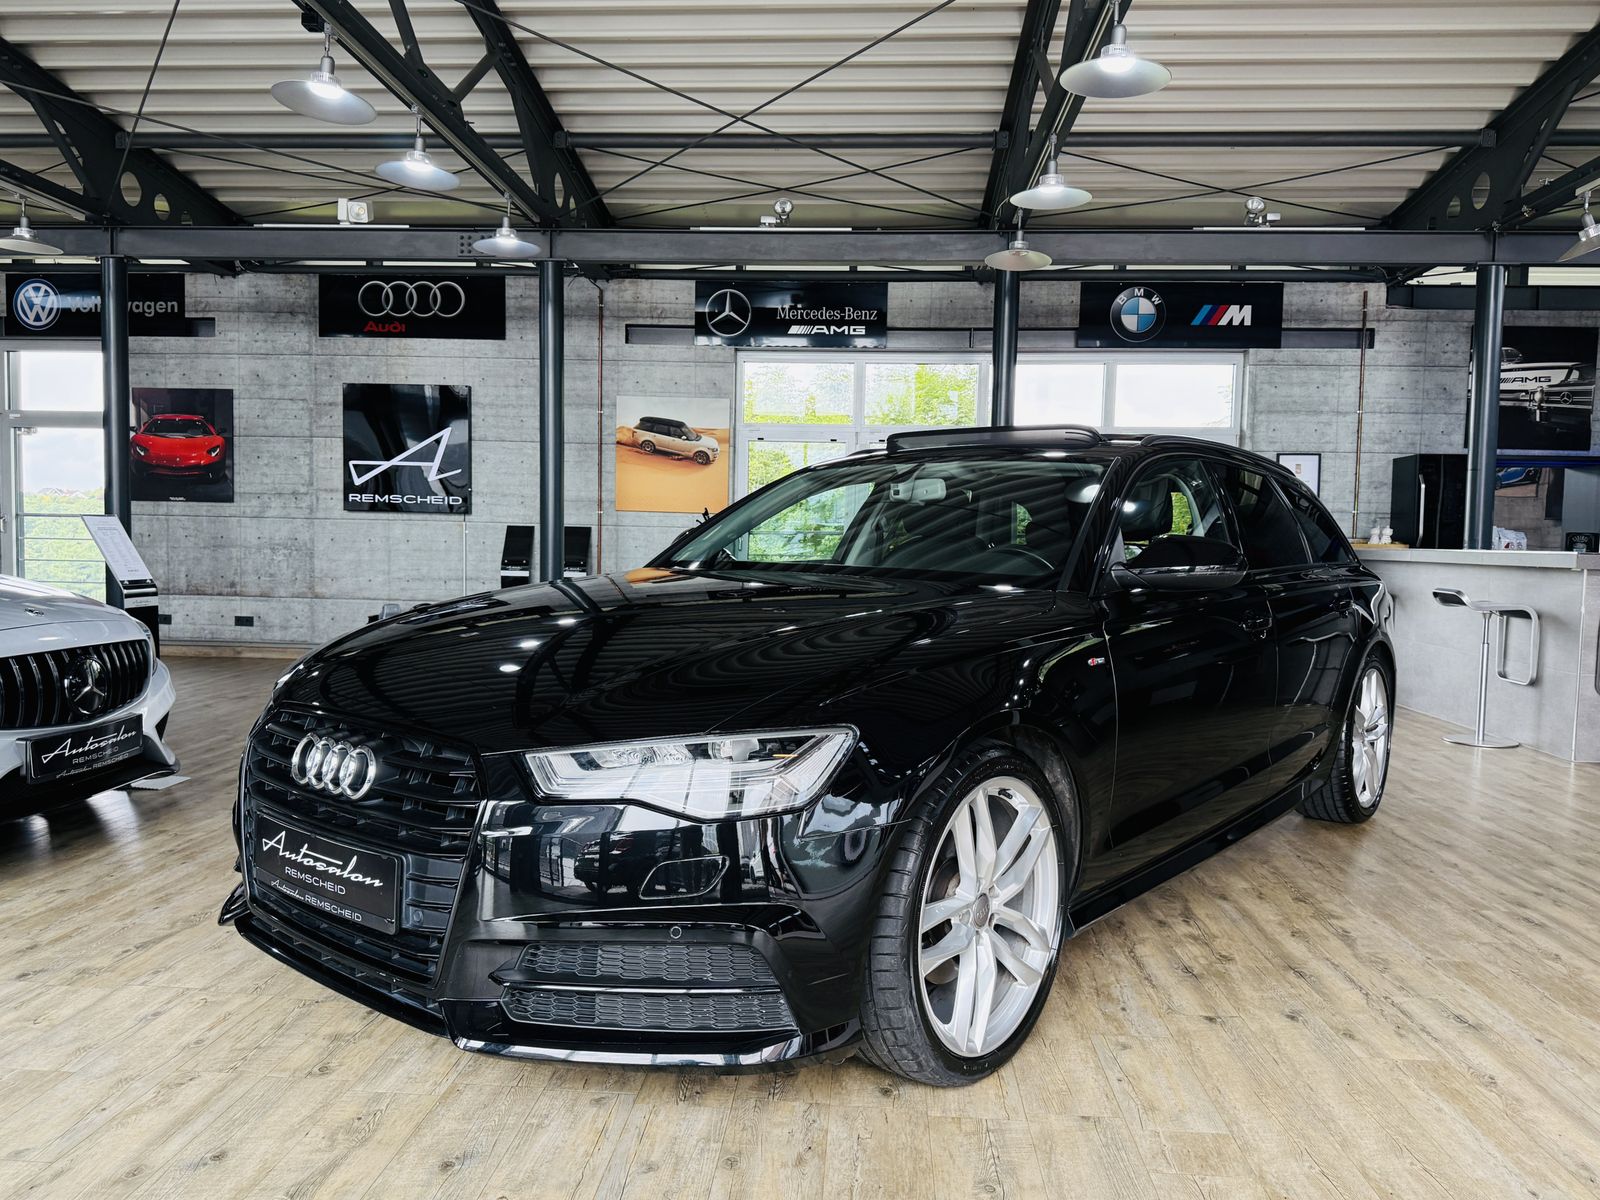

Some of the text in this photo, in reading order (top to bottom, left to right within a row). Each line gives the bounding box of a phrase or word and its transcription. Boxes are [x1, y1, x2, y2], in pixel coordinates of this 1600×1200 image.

[1117, 288, 1162, 306] BMW
[776, 306, 878, 321] Mercedes-Benz
[363, 321, 406, 333] Audi
[811, 325, 866, 335] AMG
[1511, 376, 1552, 384] AMG
[348, 493, 463, 505] REMSCHEID
[41, 725, 137, 764] Autosalon
[262, 830, 384, 887] Autosalon
[284, 866, 346, 895] REMSCHEID
[304, 894, 362, 922] REMSCHEID
